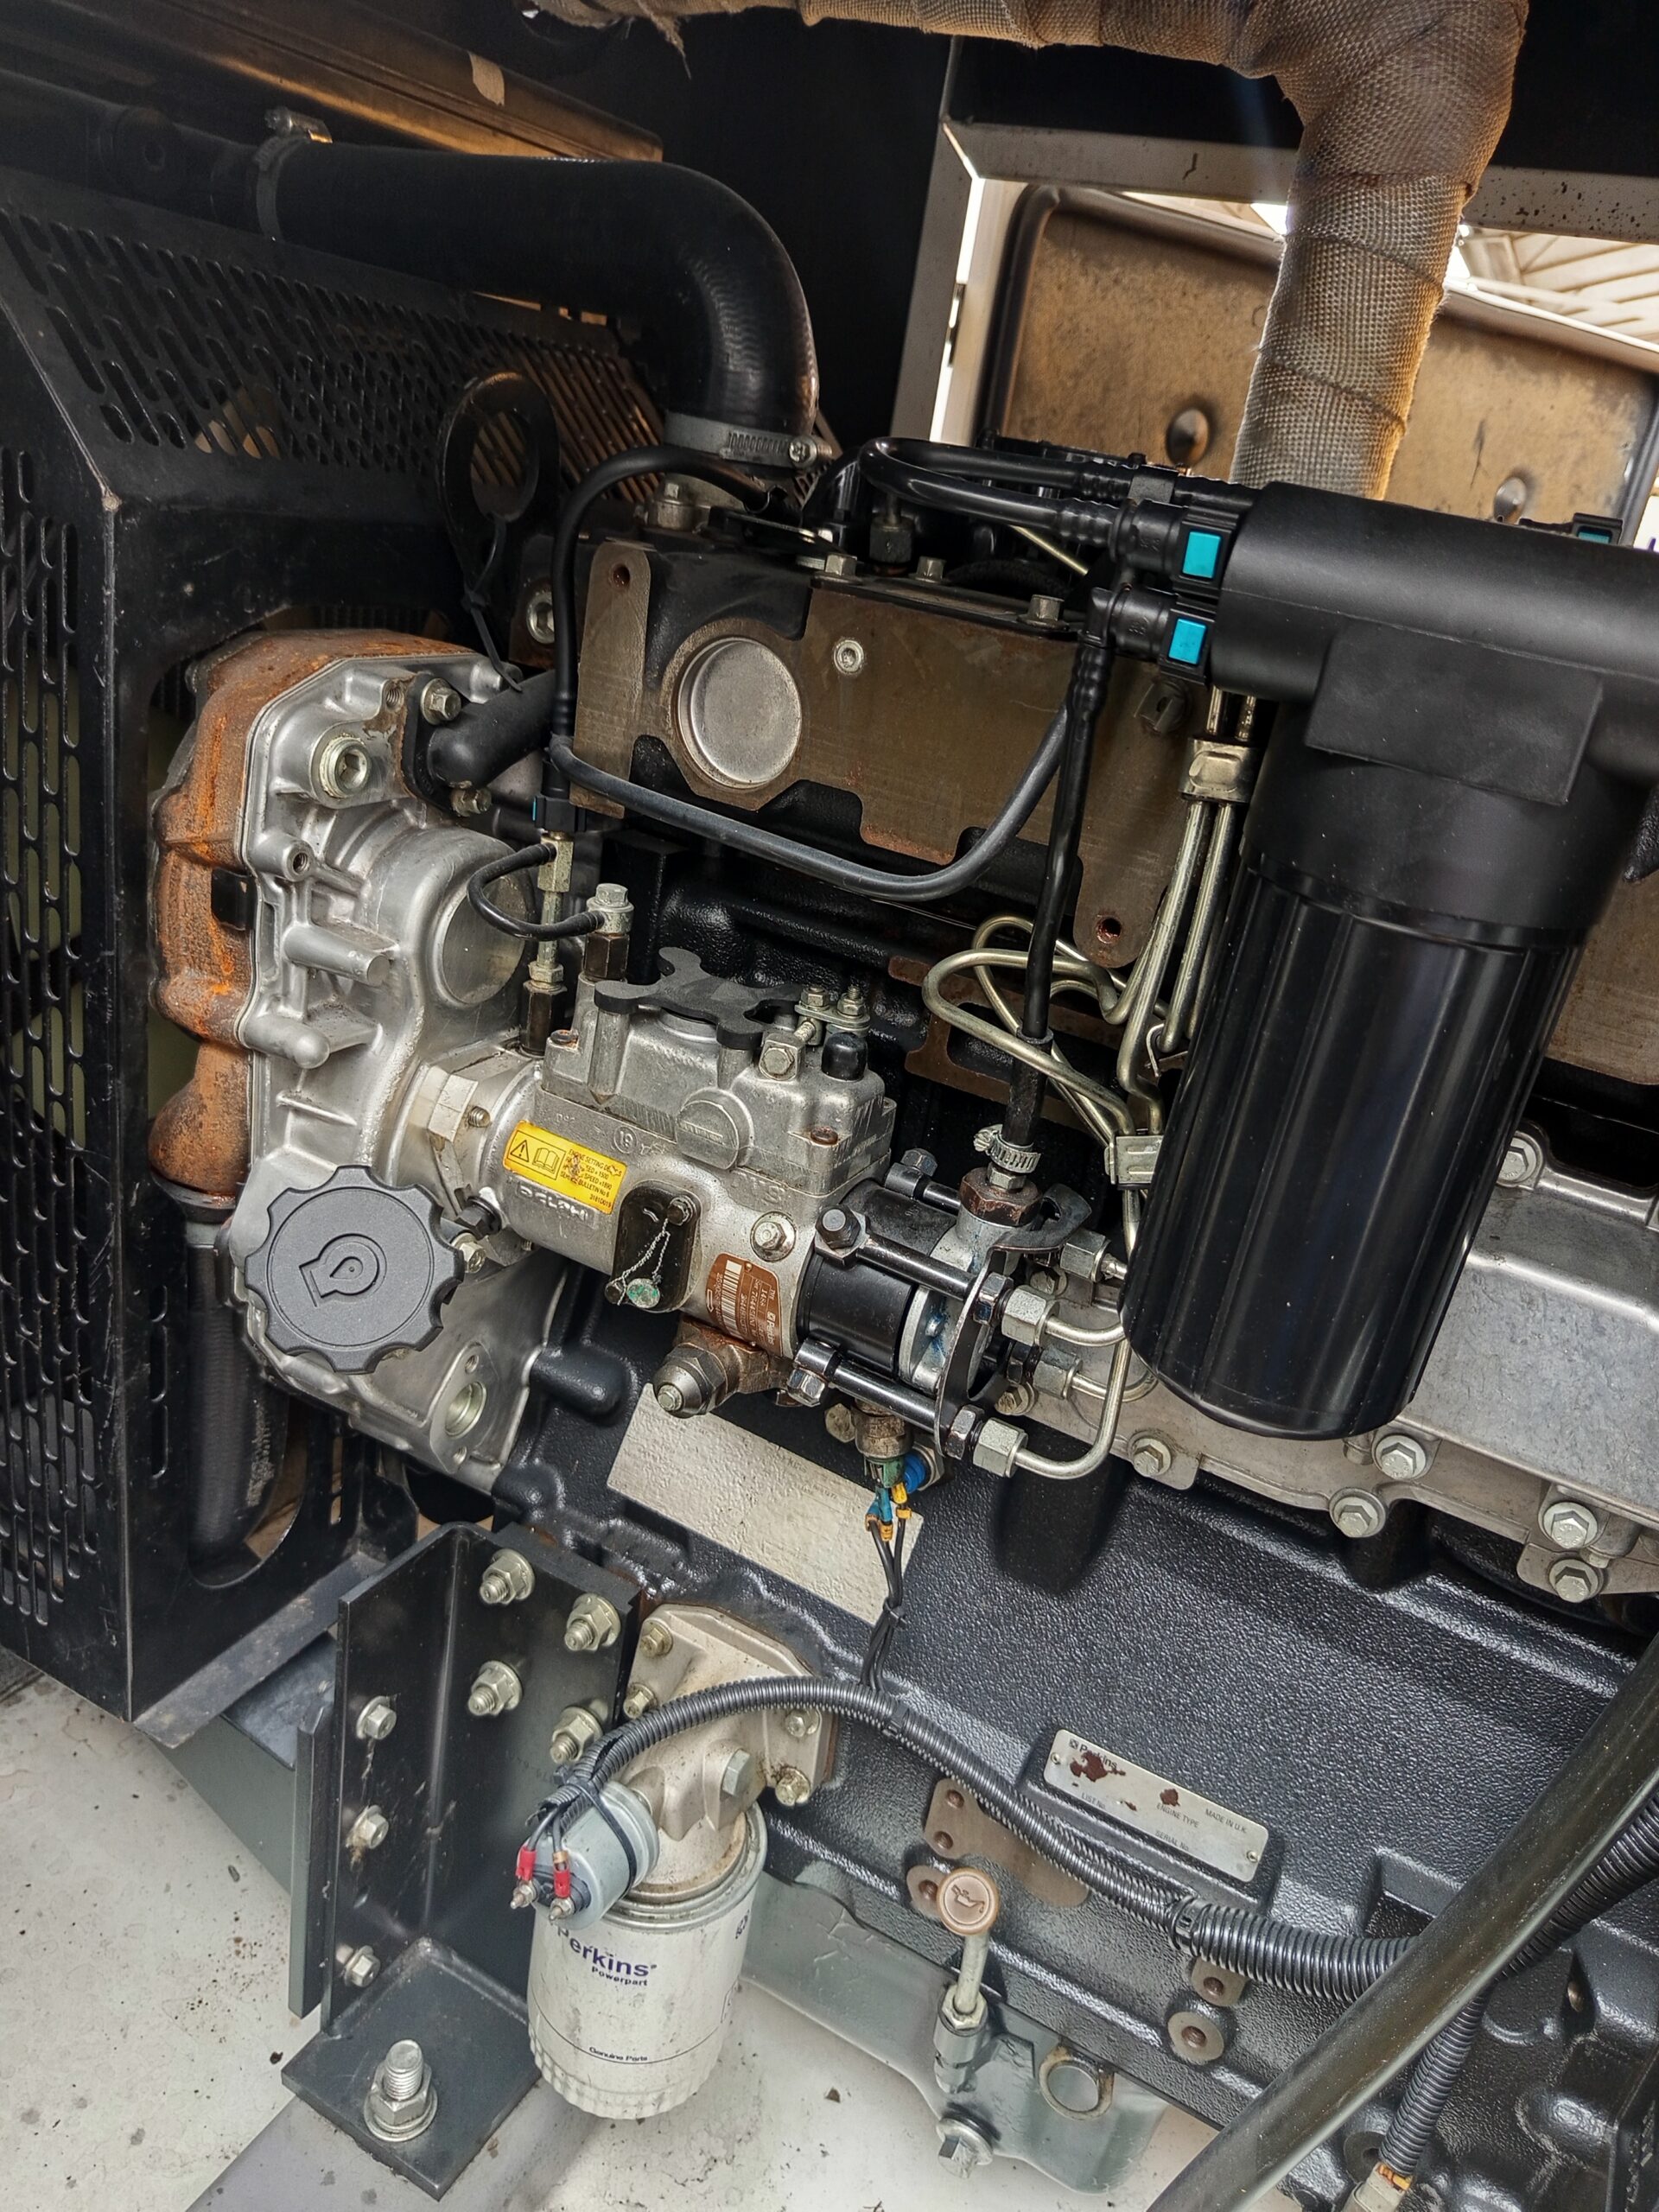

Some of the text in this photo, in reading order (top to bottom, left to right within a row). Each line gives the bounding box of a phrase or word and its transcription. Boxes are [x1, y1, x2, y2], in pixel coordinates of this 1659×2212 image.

[585, 1156, 604, 1169] SETTING
[578, 1179, 599, 1193] BULLETIN
[583, 1173, 600, 1185] SPEED
[1082, 1792, 1096, 1803] LIST
[1156, 1802, 1199, 1828] ENGINE TYPE
[1205, 1808, 1224, 1823] MADE
[1225, 1818, 1234, 1827] IN
[1155, 1830, 1179, 1847] SERIAL
[591, 1966, 649, 1986] Powerpart
